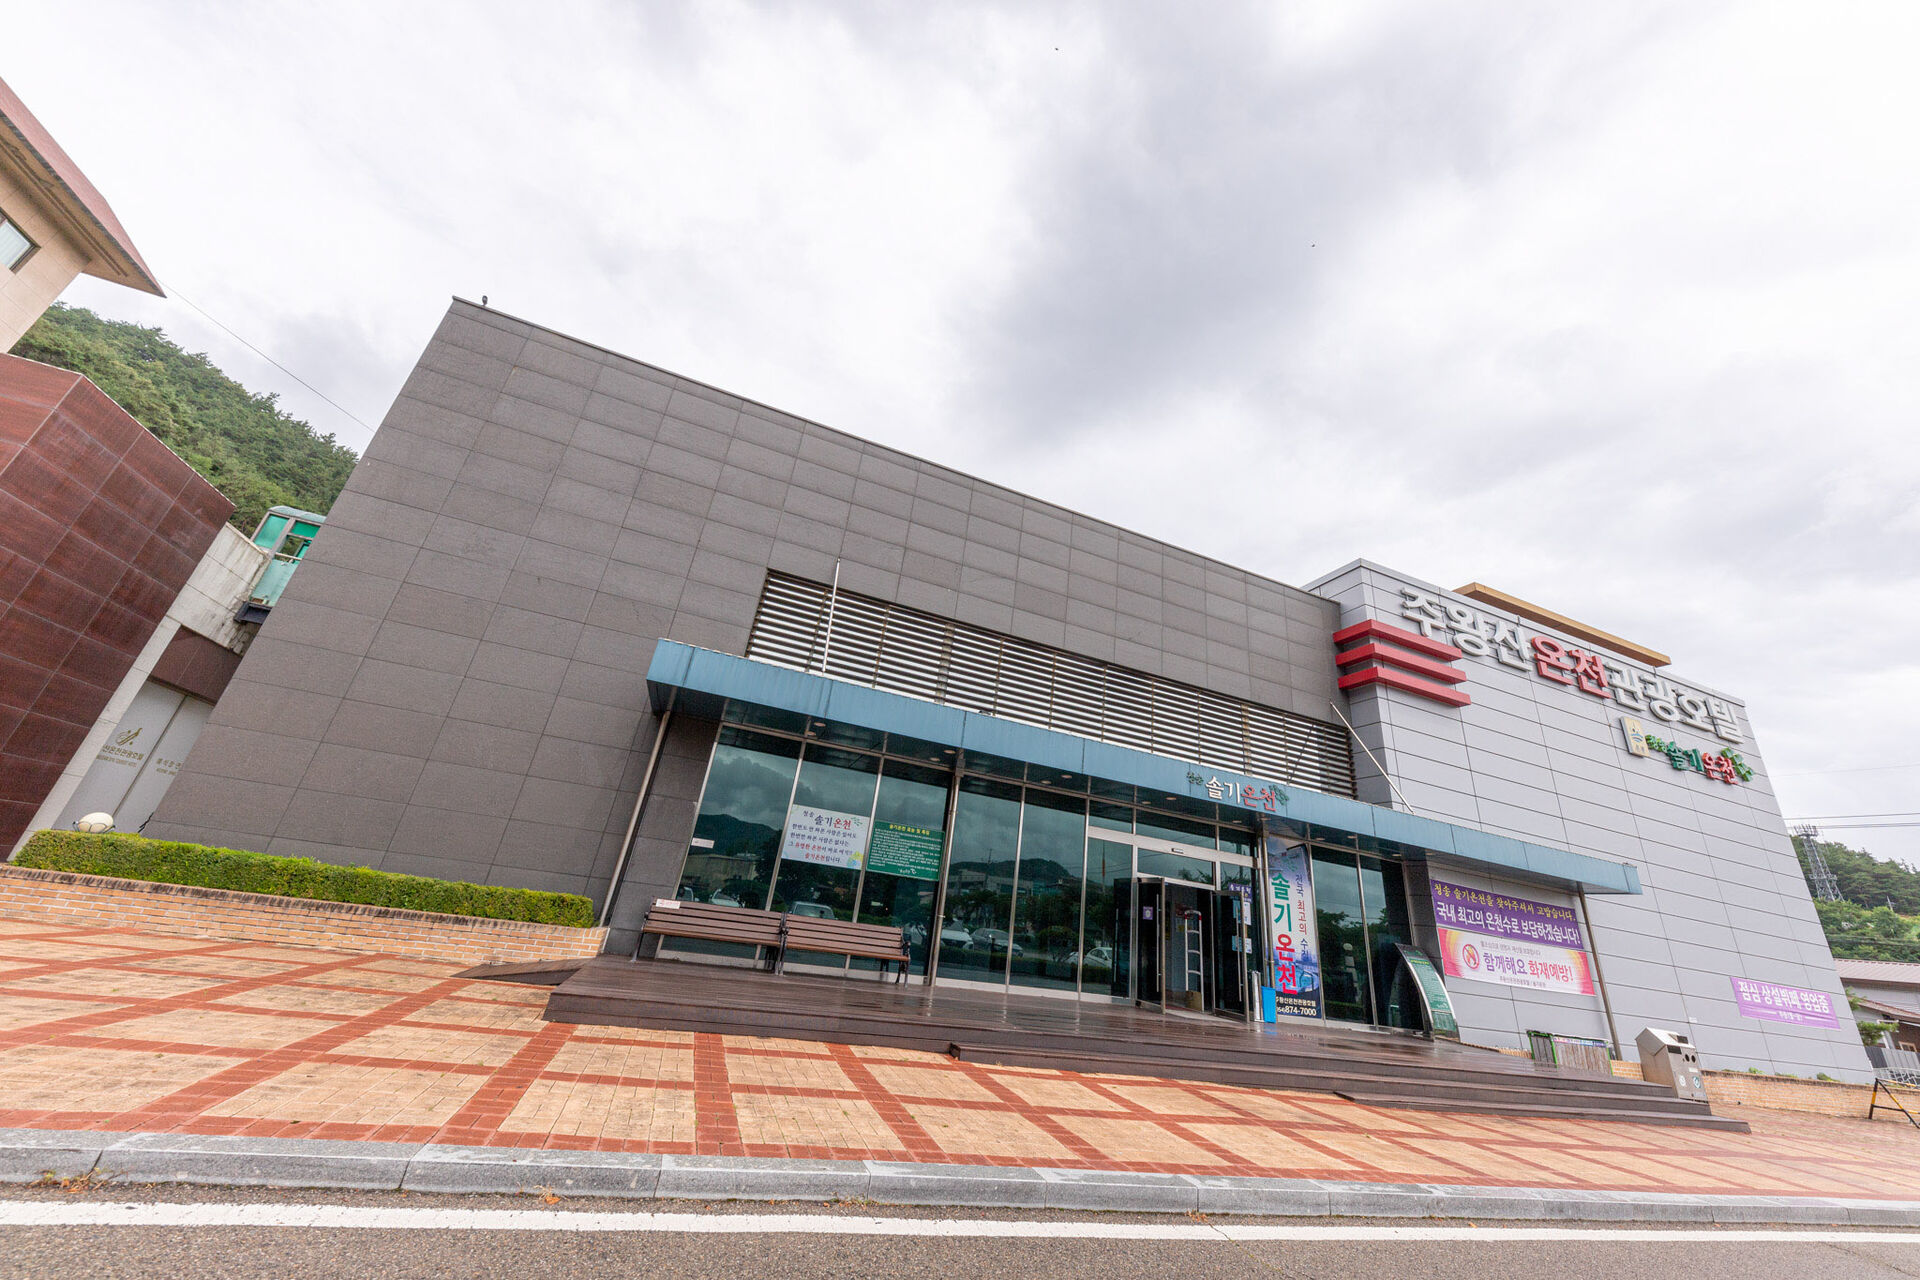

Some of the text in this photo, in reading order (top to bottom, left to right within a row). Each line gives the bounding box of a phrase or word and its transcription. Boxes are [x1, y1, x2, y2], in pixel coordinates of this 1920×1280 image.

[1401, 587, 1744, 744] 주왕산온천관광호텔
[1666, 741, 1738, 785] 솔기온천
[1205, 775, 1277, 812] 솔기온천
[815, 815, 851, 830] 솔기온천
[1297, 899, 1308, 935] 최고의
[1434, 883, 1451, 897] 청송
[1453, 888, 1494, 907] 솔기온천을
[1496, 897, 1534, 915] 찾아주셔서
[1271, 872, 1298, 995] 솔기온천
[1436, 901, 1581, 945] 국내 최고의 온천수로 보답하겠습니다!
[1483, 952, 1574, 983] 함께해요 화재예방!
[1737, 981, 1830, 1014] 점심 상설뷔페 영업중
